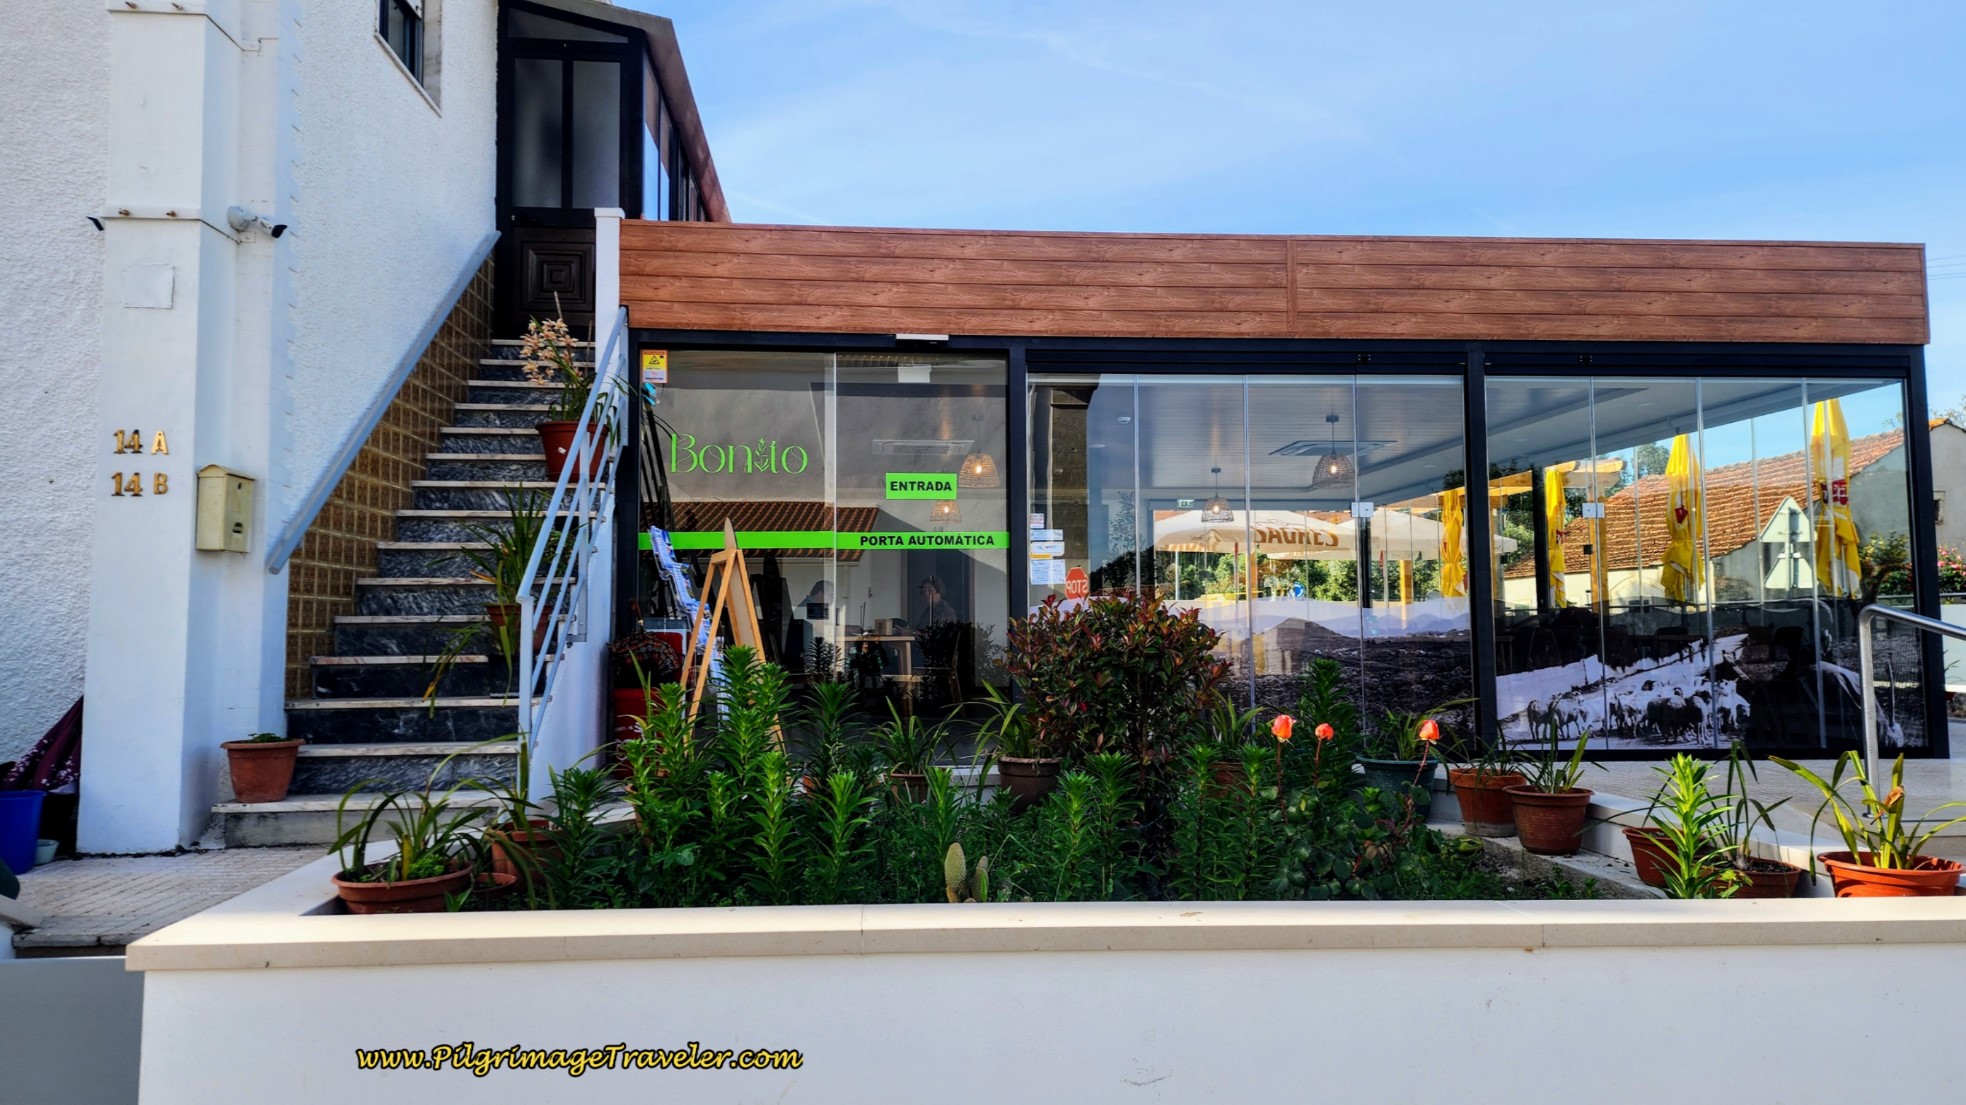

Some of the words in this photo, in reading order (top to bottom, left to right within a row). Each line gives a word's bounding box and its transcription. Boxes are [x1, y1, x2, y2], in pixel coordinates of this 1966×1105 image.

[113, 428, 143, 455] 14
[150, 430, 170, 455] A
[669, 433, 809, 474] Bonito
[110, 471, 143, 497] 14
[153, 472, 169, 495] B
[889, 480, 952, 493] ENTRADA
[859, 534, 905, 547] PORTA
[908, 532, 995, 547] AUTOMÁTICA
